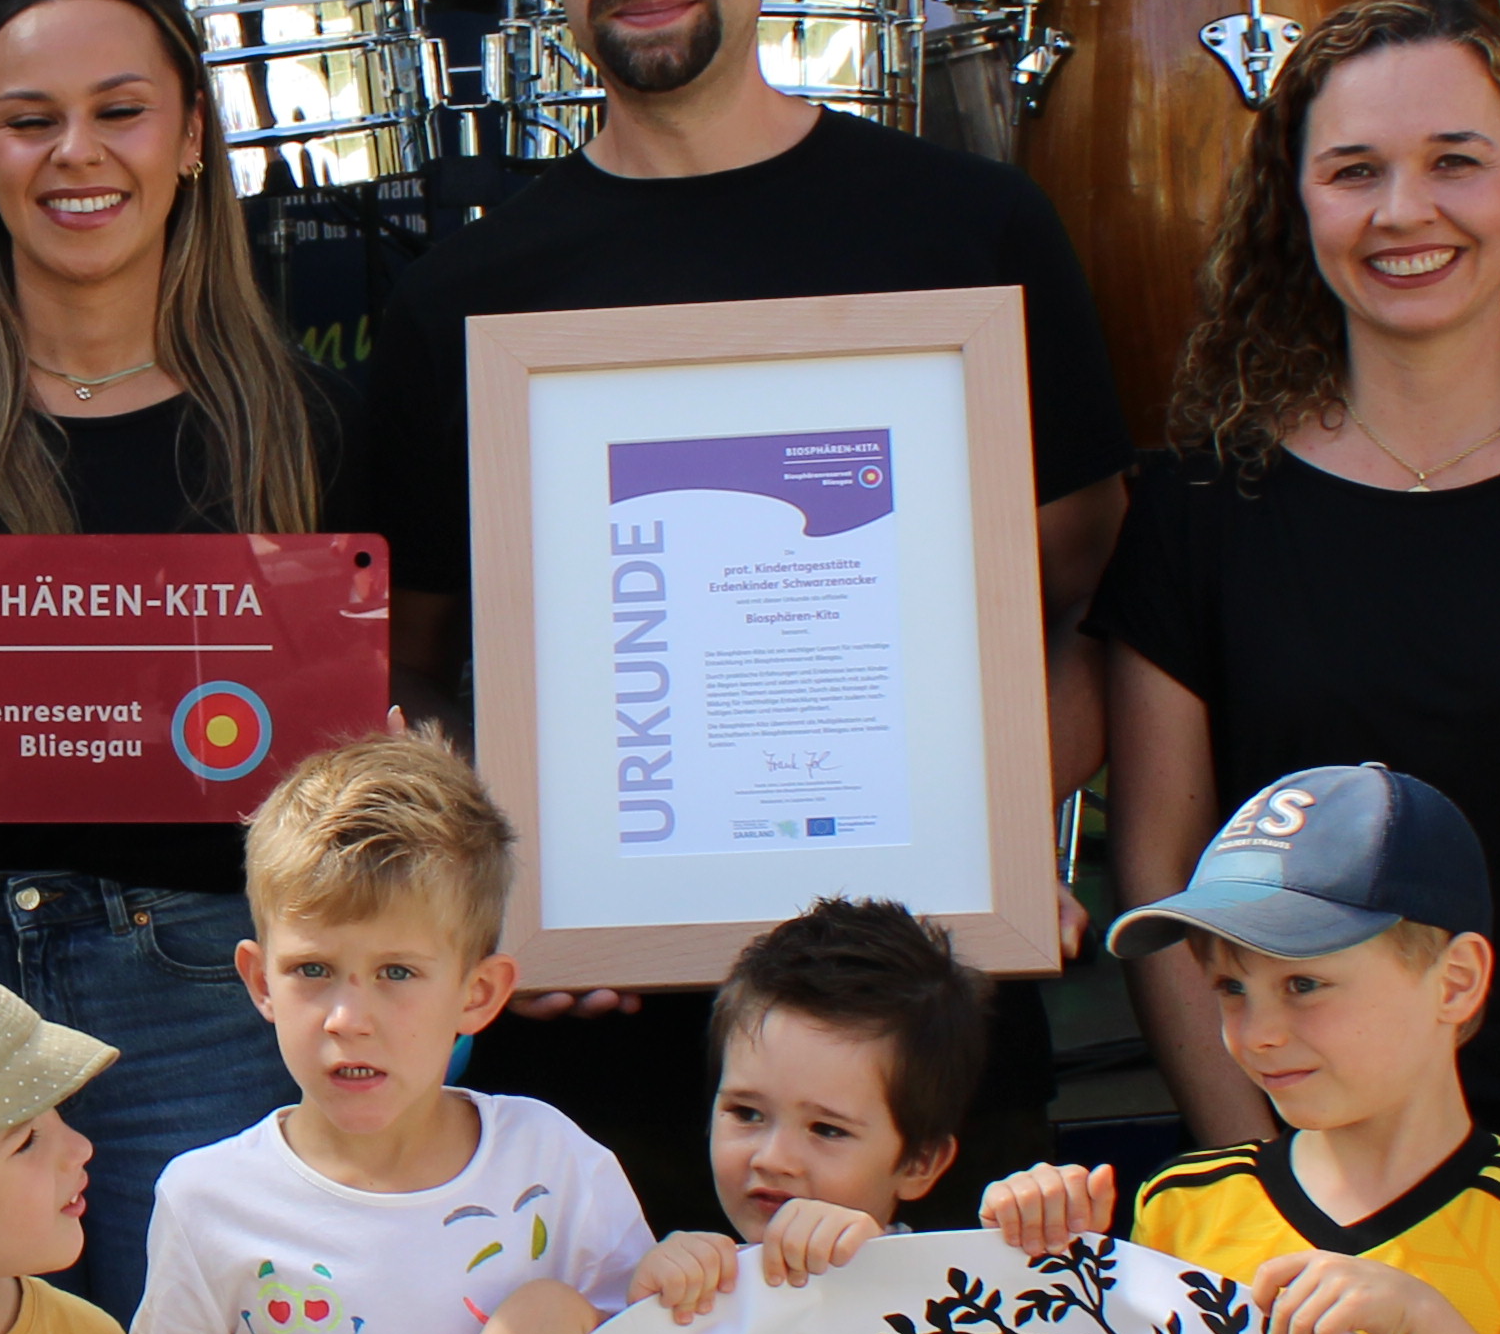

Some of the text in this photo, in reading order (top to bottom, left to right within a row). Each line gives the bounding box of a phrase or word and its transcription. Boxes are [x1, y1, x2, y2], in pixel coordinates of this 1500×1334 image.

[785, 442, 881, 457] BIOSPHÄREN-KITA
[724, 557, 862, 578] prot. Kindertagesstätte
[708, 574, 878, 593] Erdenkinder Schwarzenacker
[745, 609, 840, 625] Biosphären-Kita
[610, 518, 676, 845] URKUNDE
[19, 733, 143, 763] Bliesgau
